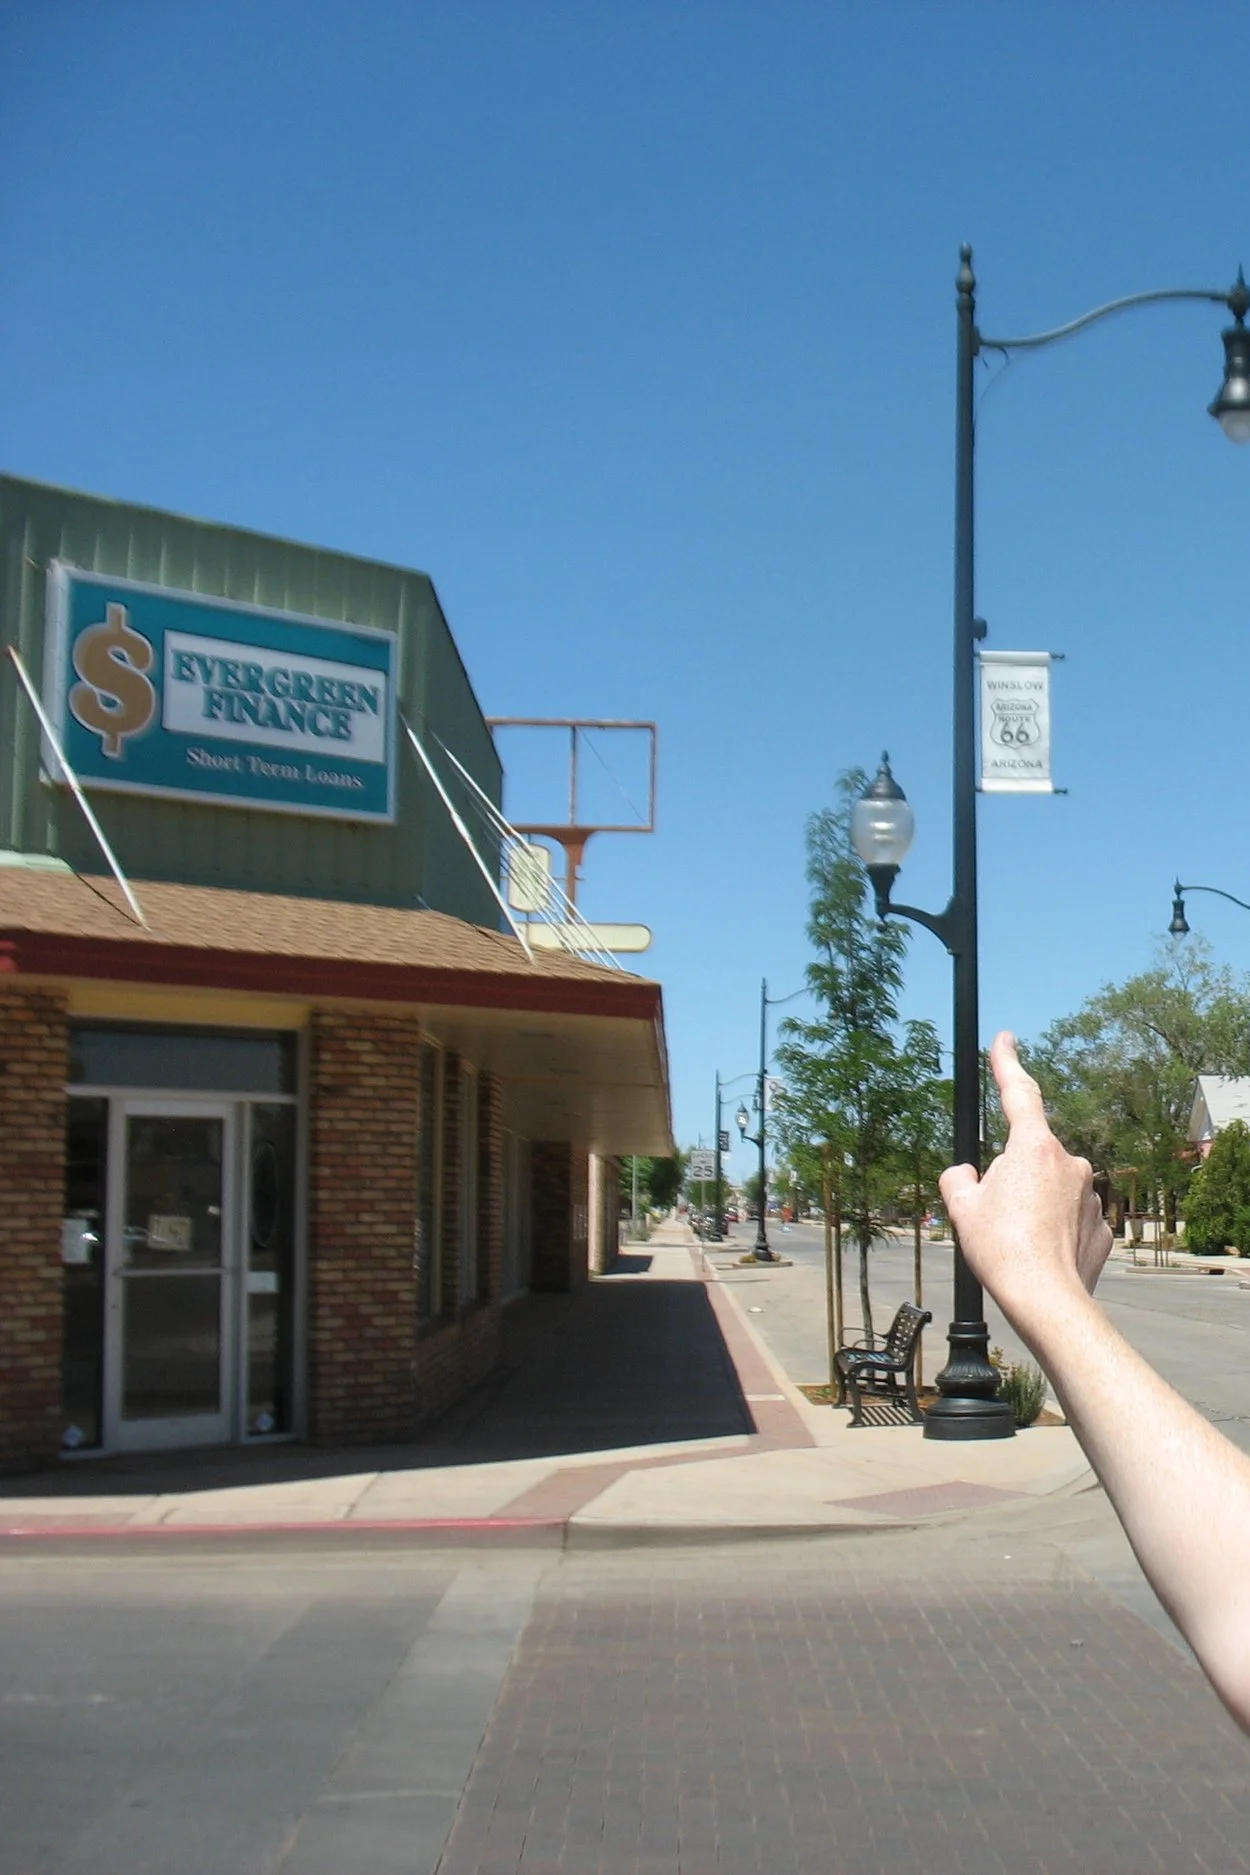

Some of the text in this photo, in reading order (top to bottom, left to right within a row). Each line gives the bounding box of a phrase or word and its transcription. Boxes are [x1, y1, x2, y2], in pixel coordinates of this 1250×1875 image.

[170, 649, 379, 715] EVERGREEN
[987, 680, 1043, 690] WINSLOW
[202, 688, 352, 742] FINANCE
[1000, 722, 1029, 743] 66
[186, 747, 364, 789] Short Term Loans
[991, 759, 1043, 769] ARIZONA
[693, 1165, 713, 1177] 25
